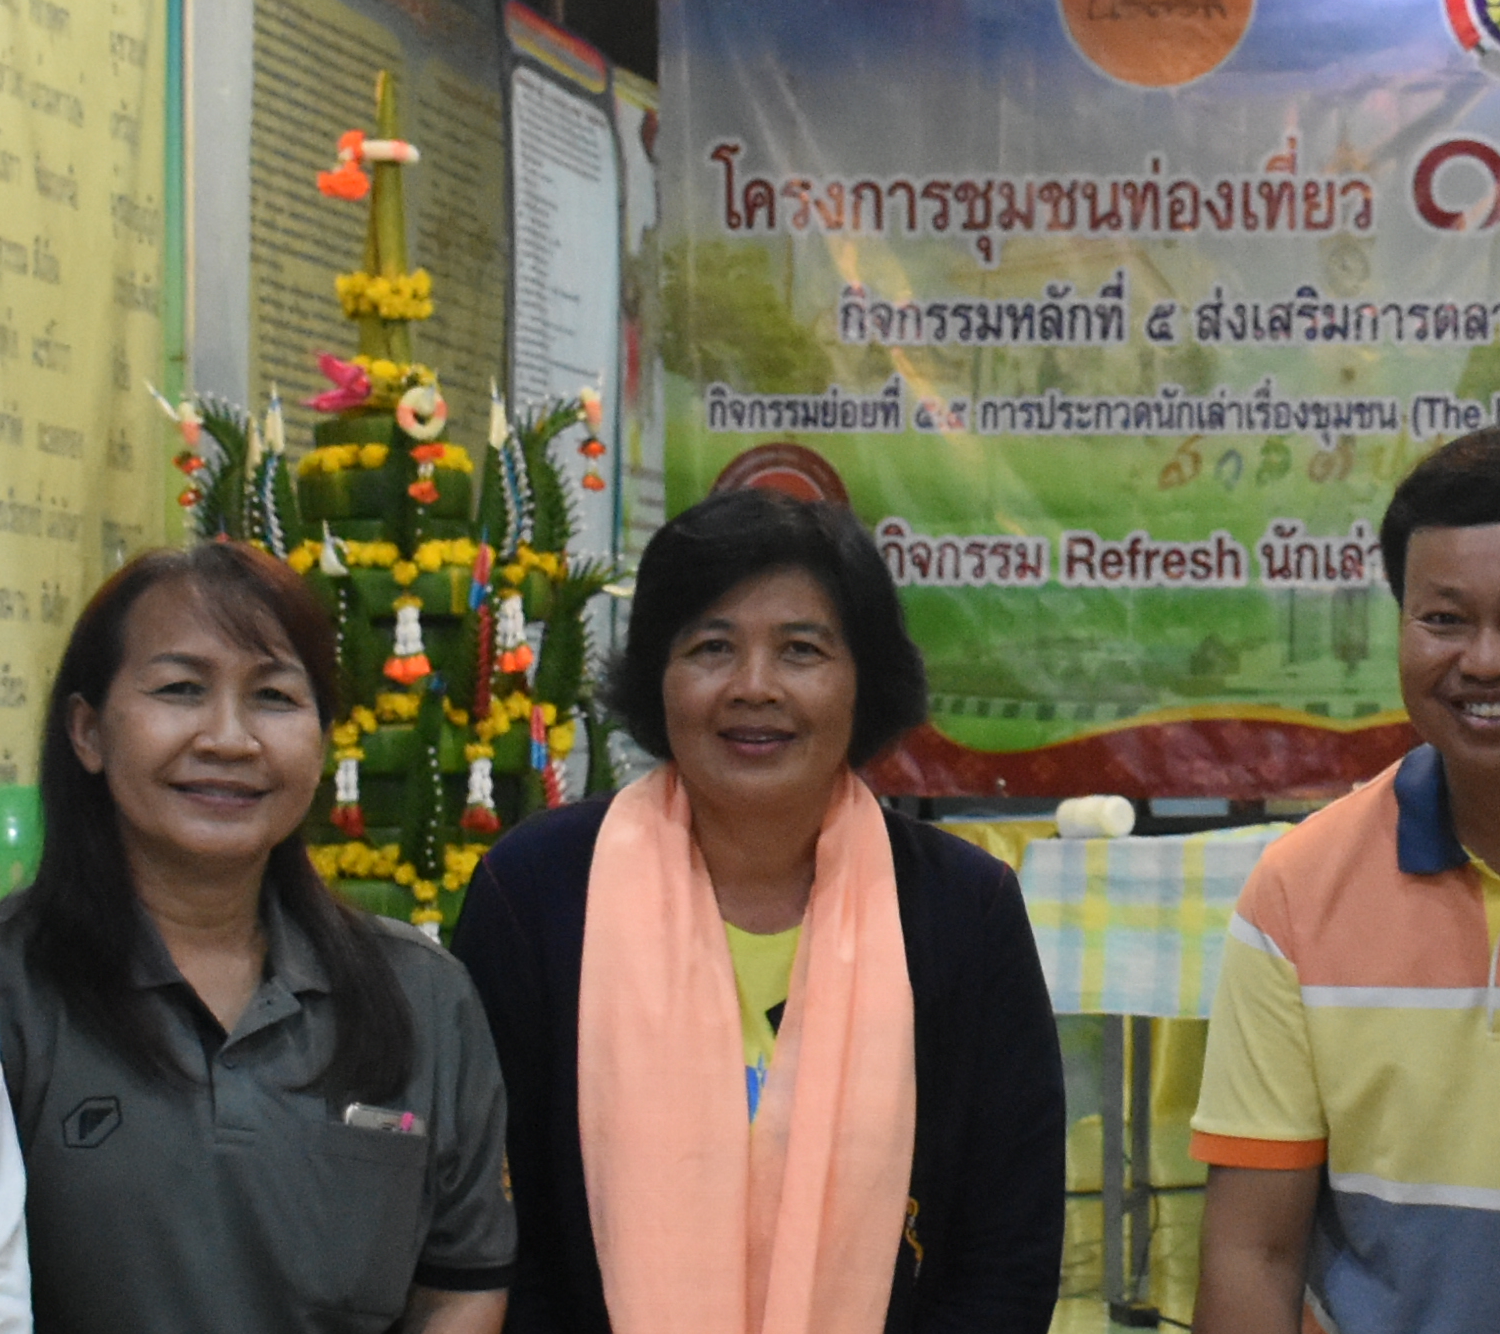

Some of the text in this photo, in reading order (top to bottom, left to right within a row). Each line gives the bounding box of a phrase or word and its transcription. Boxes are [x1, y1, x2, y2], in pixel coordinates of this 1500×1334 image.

[711, 137, 1374, 264] โครงการชุมชนท่องเที่ยว
[840, 269, 1126, 343] กิจกรรมหลักที่
[1144, 302, 1176, 343] ๕
[708, 373, 901, 429] กิจกรรมย่อยที่
[980, 377, 1397, 449] การประกวดนักเล่าเรื่องชุมชน
[1411, 393, 1480, 437] (The
[880, 519, 1043, 581] กิจกรรม
[1065, 534, 1240, 581] Refresh
